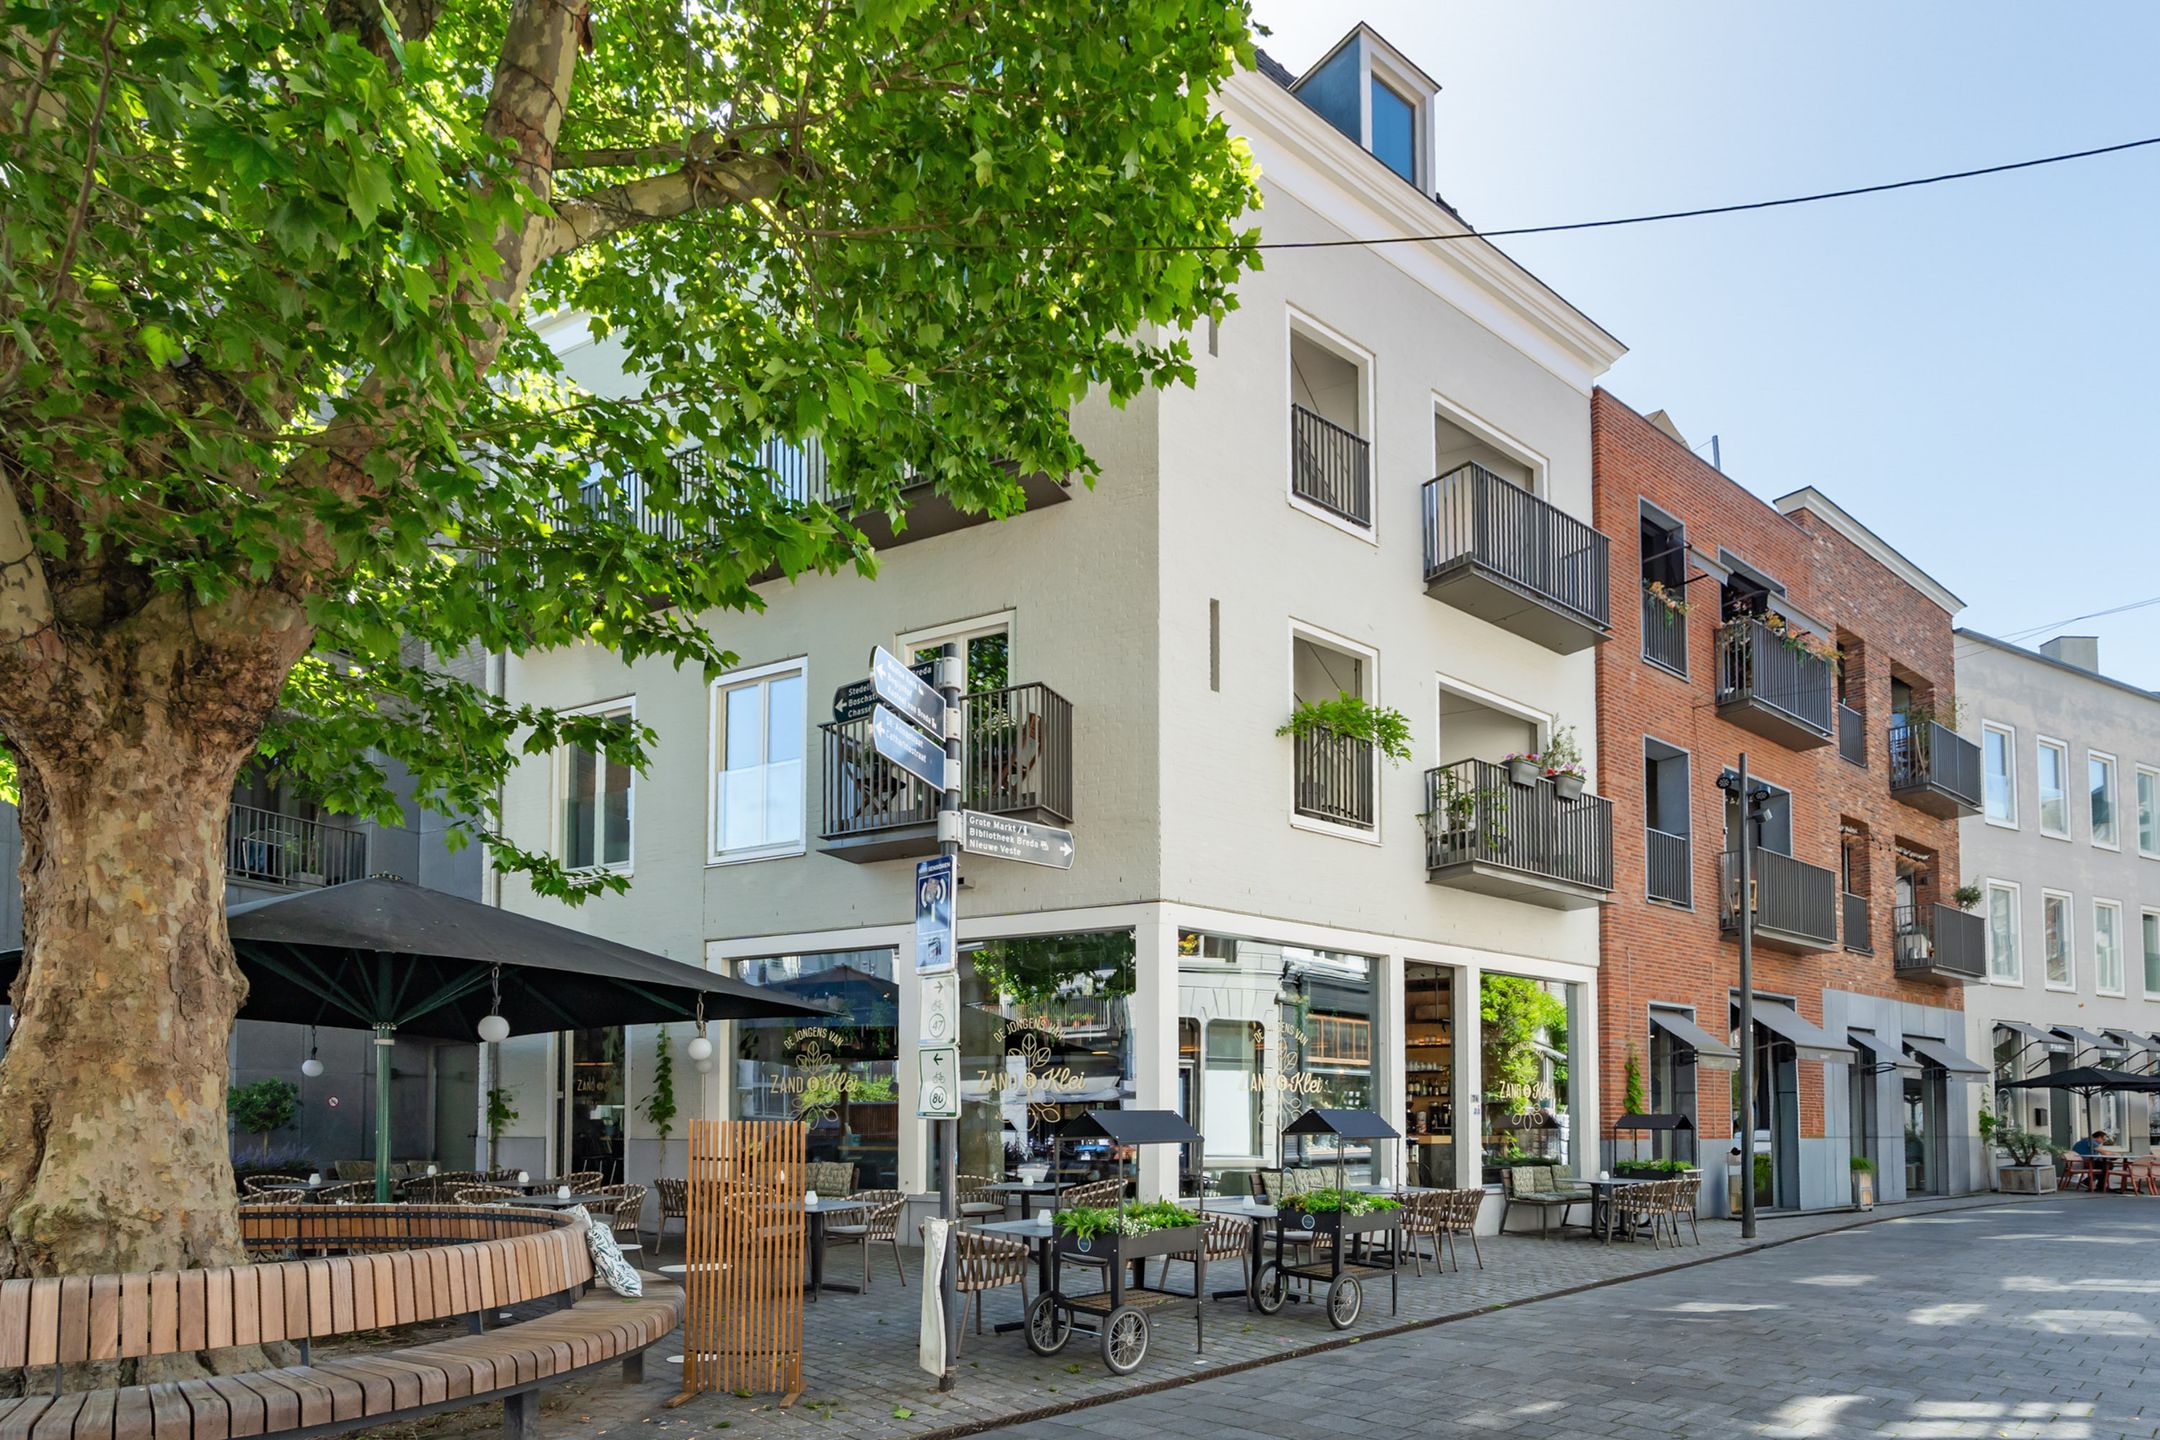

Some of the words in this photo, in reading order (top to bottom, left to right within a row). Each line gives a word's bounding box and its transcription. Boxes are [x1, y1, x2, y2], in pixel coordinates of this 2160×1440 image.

[848, 694, 878, 707] Boschstr
[969, 816, 991, 827] Grote
[993, 821, 1016, 833] Markt
[969, 827, 1015, 844] Bibliotheek
[1016, 837, 1039, 848] Breda
[969, 839, 998, 852] Nieuwe
[1000, 845, 1022, 856] Veste
[932, 1020, 944, 1031] 47
[993, 1028, 1006, 1042] DE
[1006, 1017, 1045, 1035] JONGENS
[783, 1036, 795, 1049] DE
[795, 1026, 828, 1042] JONGENS
[828, 1031, 845, 1047] VAN
[1253, 1028, 1265, 1043] DE
[1295, 1028, 1309, 1046] VAN
[822, 1072, 859, 1093] Klei
[1041, 1067, 1086, 1092] Klei
[1289, 1072, 1323, 1095] Klei
[932, 1093, 944, 1104] 80
